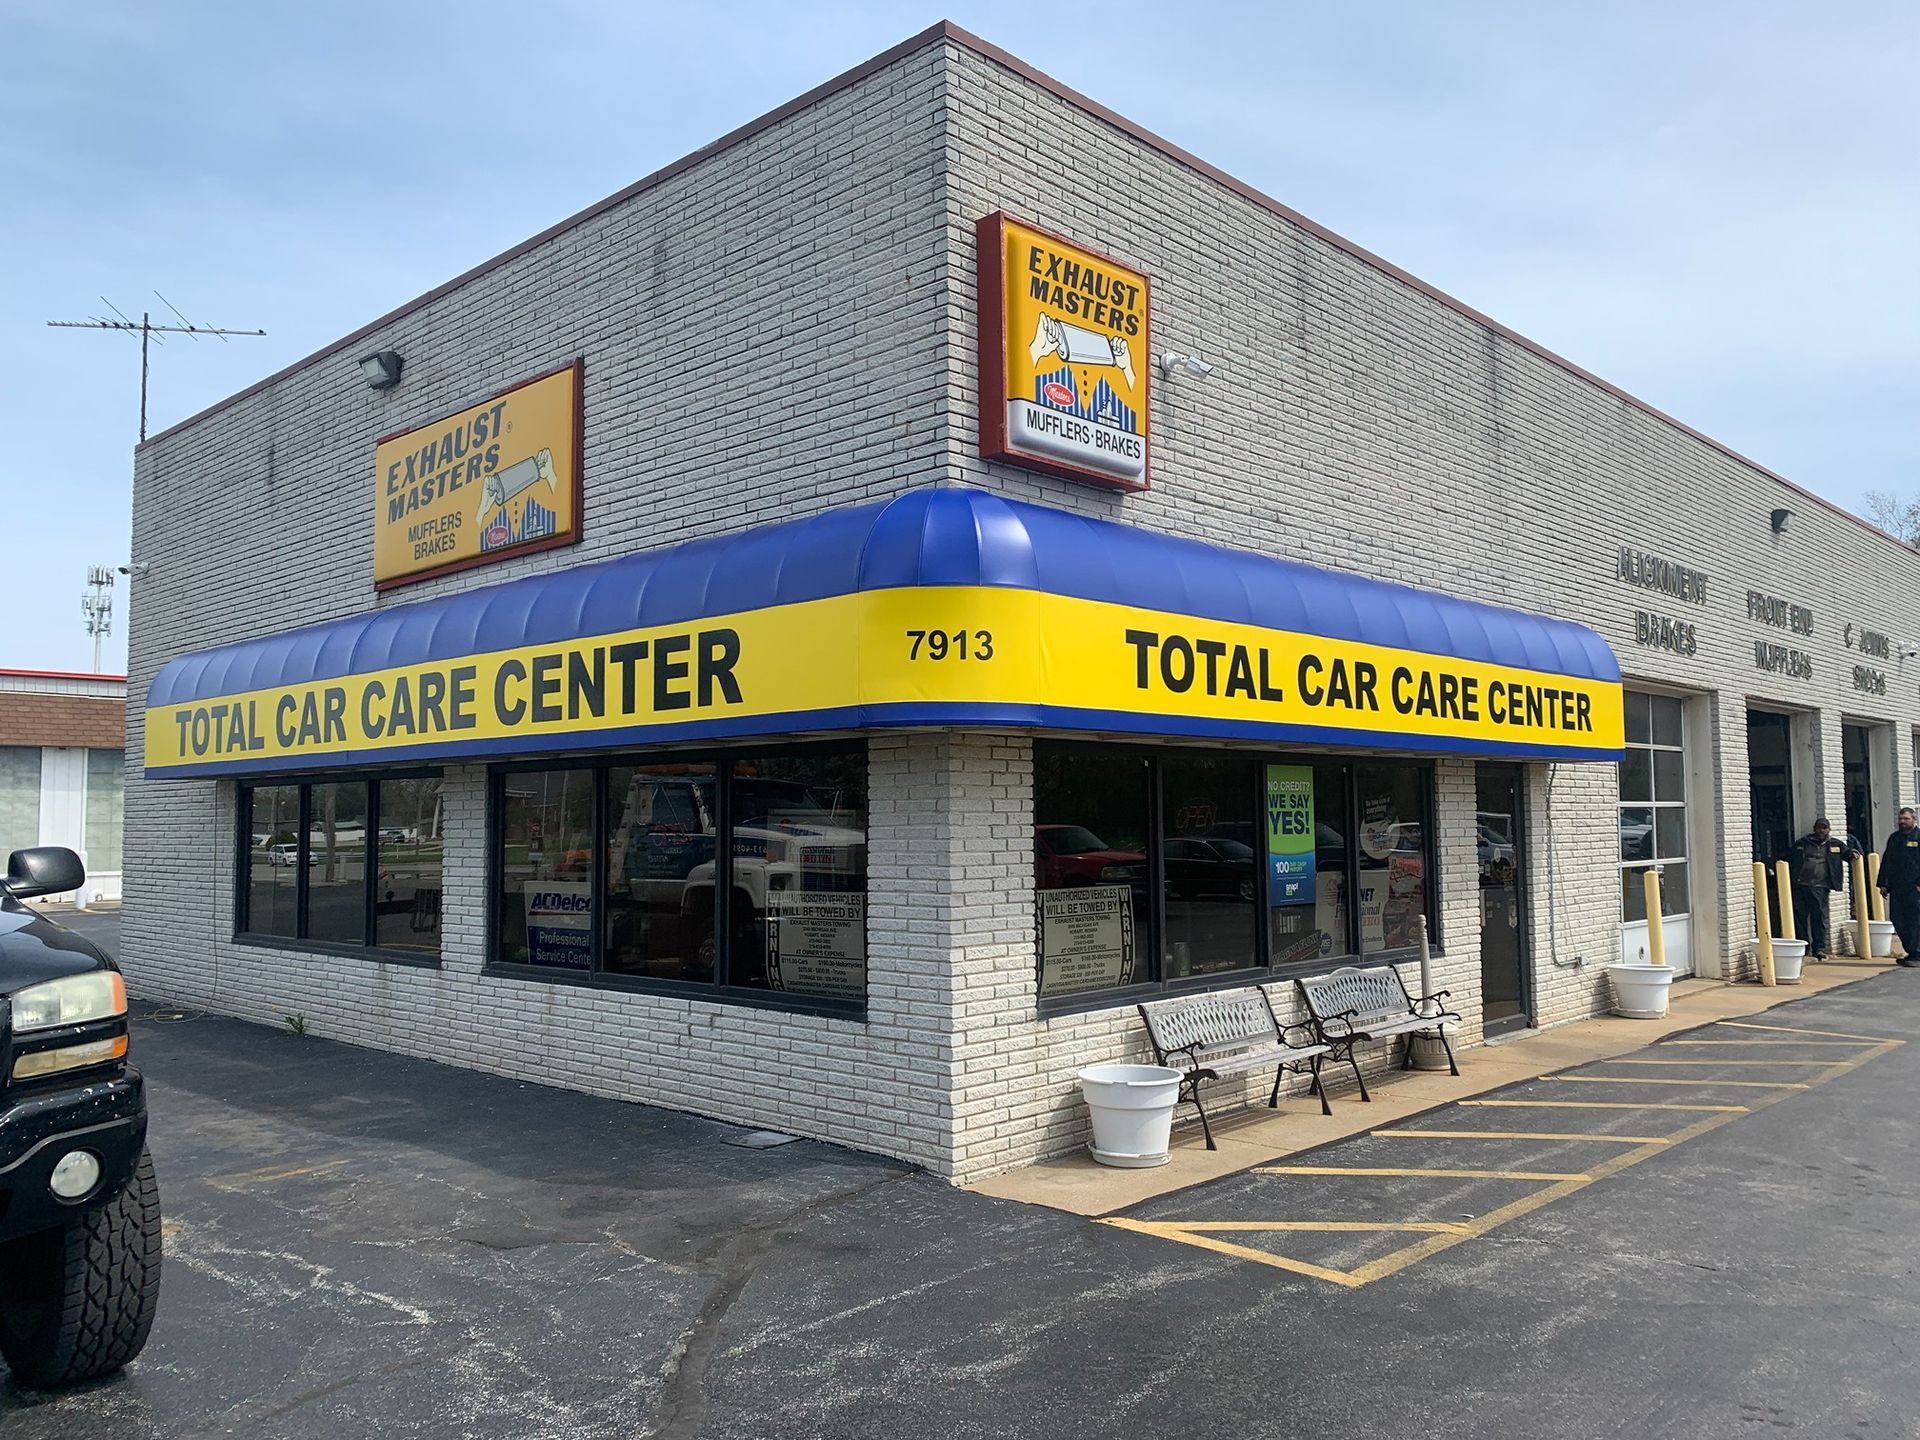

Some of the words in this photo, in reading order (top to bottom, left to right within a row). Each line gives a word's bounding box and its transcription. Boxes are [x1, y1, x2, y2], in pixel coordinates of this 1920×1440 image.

[1029, 246, 1139, 311] EXHAUST
[1030, 277, 1139, 337] MASTERS
[387, 400, 507, 496] EXHAUST
[387, 444, 501, 525] MASTERS
[408, 511, 462, 543] MUFFLERS
[414, 533, 456, 560] BRAKES
[1617, 545, 1708, 606] ALIGNMENT
[906, 629, 994, 662] 7913
[1635, 609, 1697, 657] BRAKES
[175, 702, 265, 758] TOTAL
[275, 686, 347, 747] CAR
[360, 666, 477, 739] CARE
[493, 628, 744, 726] CENTER
[1126, 629, 1283, 703] TOTAL
[1297, 653, 1380, 711] CAR
[1391, 666, 1479, 721] CARE
[1488, 682, 1593, 732] CENTER
[1268, 781, 1278, 791] NO
[1280, 781, 1310, 791] CREDIT?
[1269, 794, 1286, 809] WE
[1289, 794, 1310, 809] SAY
[1269, 811, 1310, 835] YES!
[1276, 861, 1289, 873] 100
[530, 892, 592, 912] ACDelco
[828, 894, 860, 906] VEHICLES
[1045, 889, 1090, 903] UNAUTHORIZED
[1090, 888, 1117, 900] VEHICLES
[1046, 904, 1065, 915] WILL
[1068, 903, 1078, 913] BE
[1079, 902, 1105, 912] TOWED
[1108, 901, 1117, 911] BY
[781, 906, 800, 916] WILL
[803, 906, 814, 916] BE
[815, 907, 845, 918] TOWED
[848, 908, 860, 918] BY
[539, 931, 590, 947] Professional
[536, 948, 566, 962] Service
[567, 951, 592, 966] Cente
